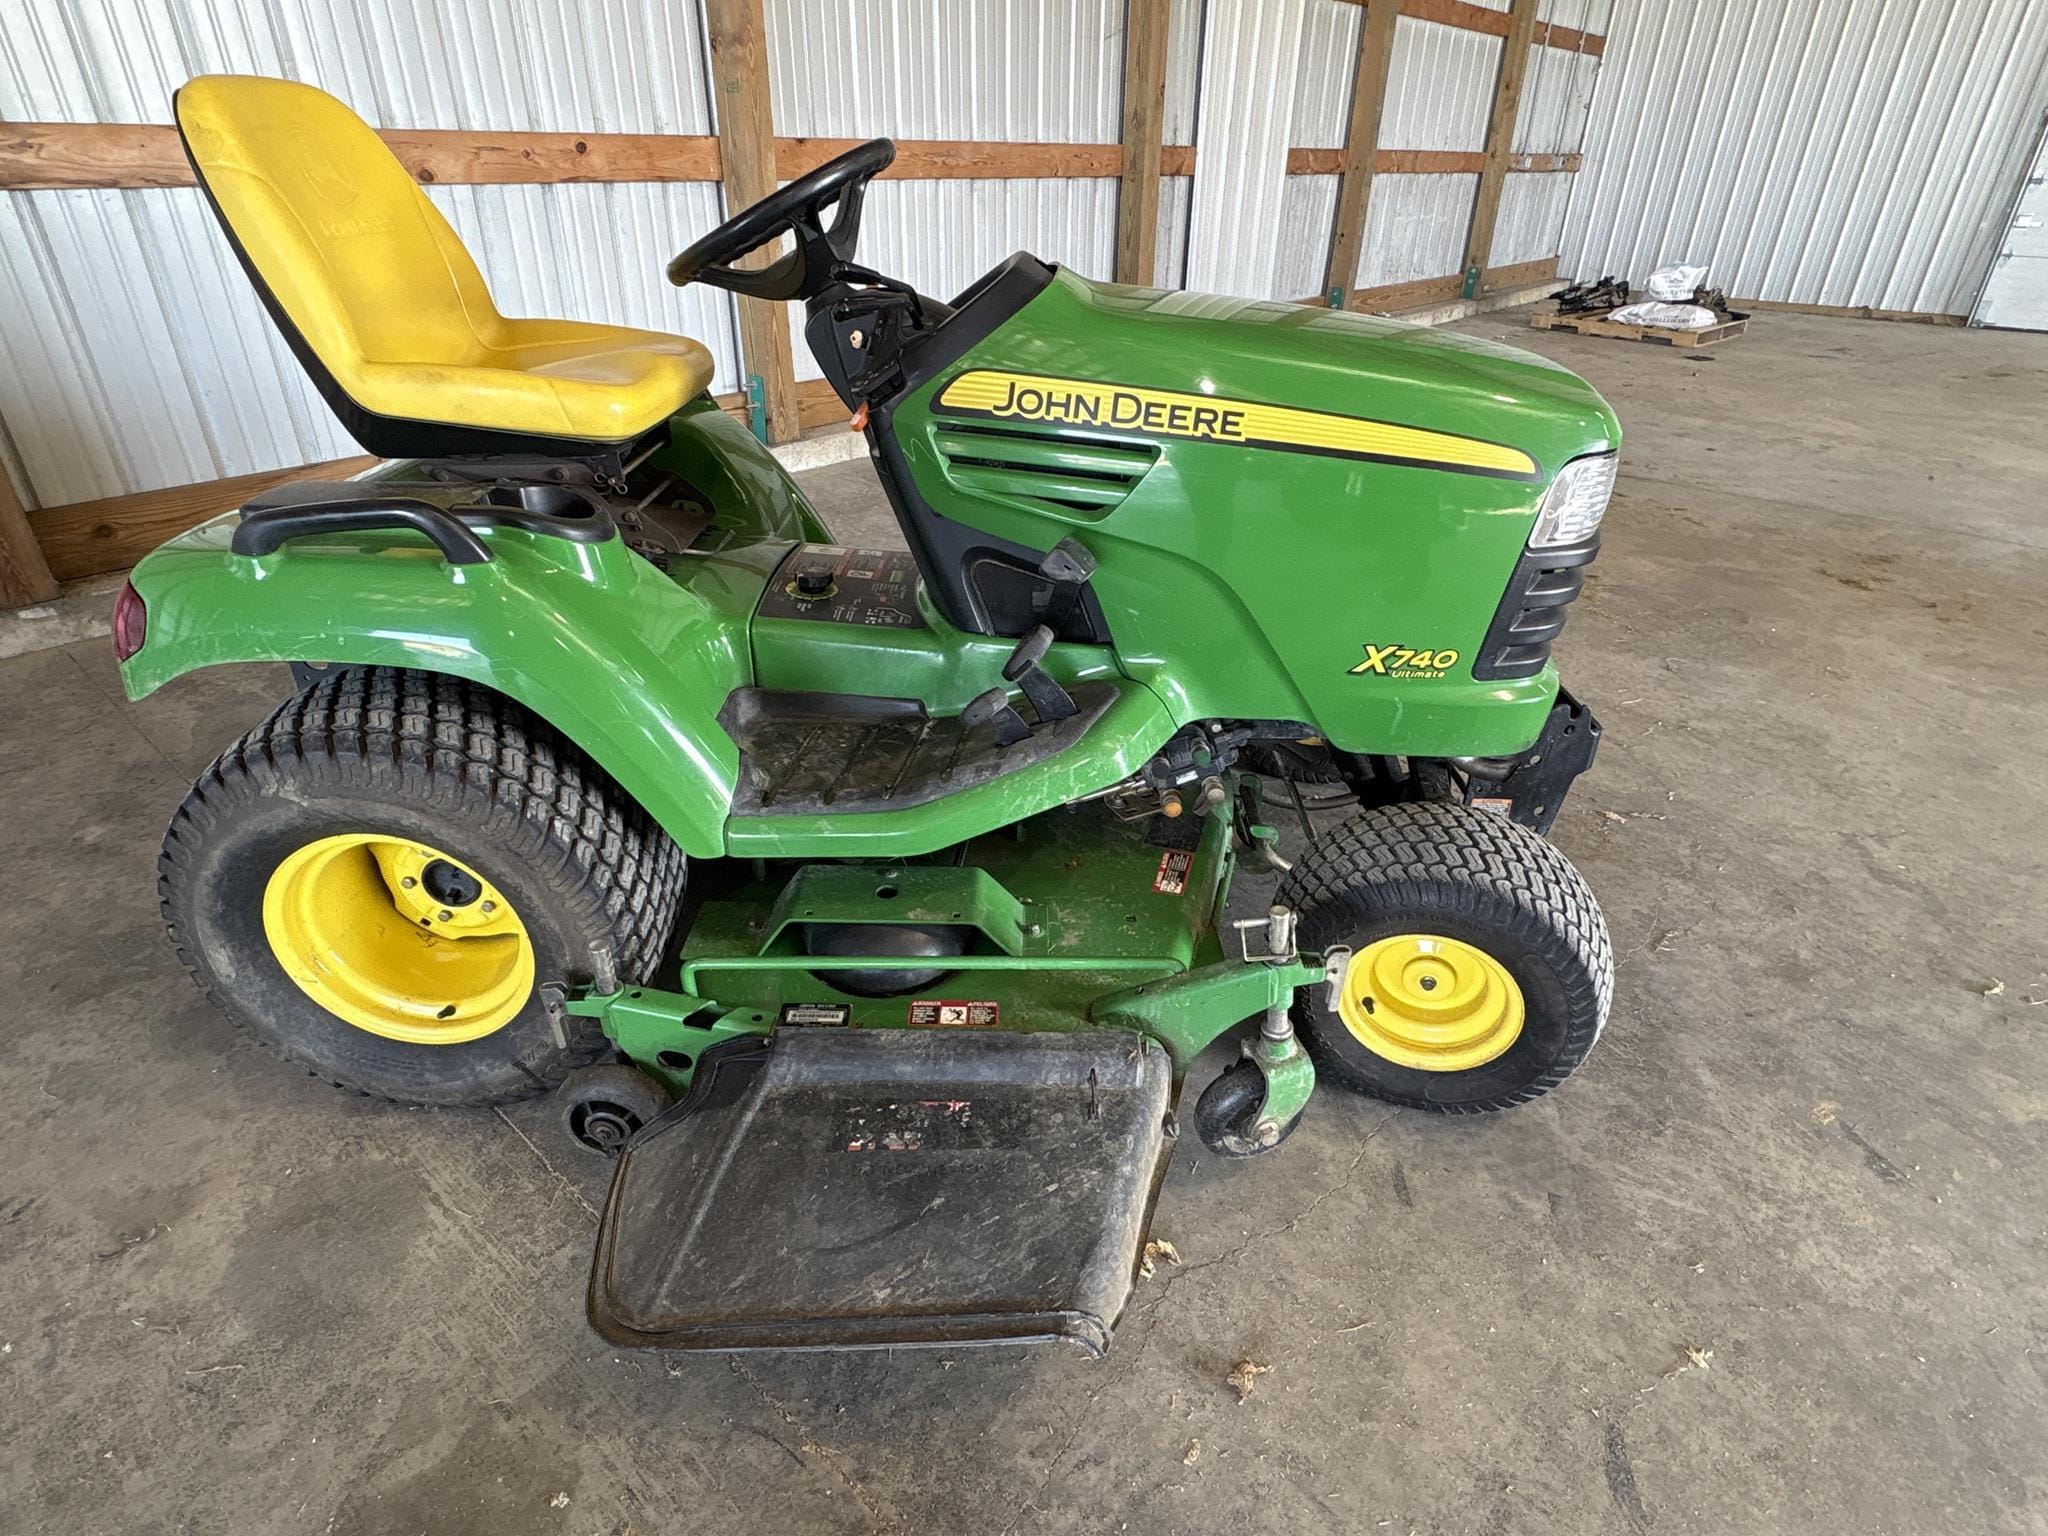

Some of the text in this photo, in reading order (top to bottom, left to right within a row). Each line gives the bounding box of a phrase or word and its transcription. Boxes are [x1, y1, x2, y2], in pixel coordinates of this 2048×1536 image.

[992, 381, 1246, 437] JOHN DEERE
[1347, 644, 1459, 675] X740
[1391, 669, 1446, 679] Ultimate
